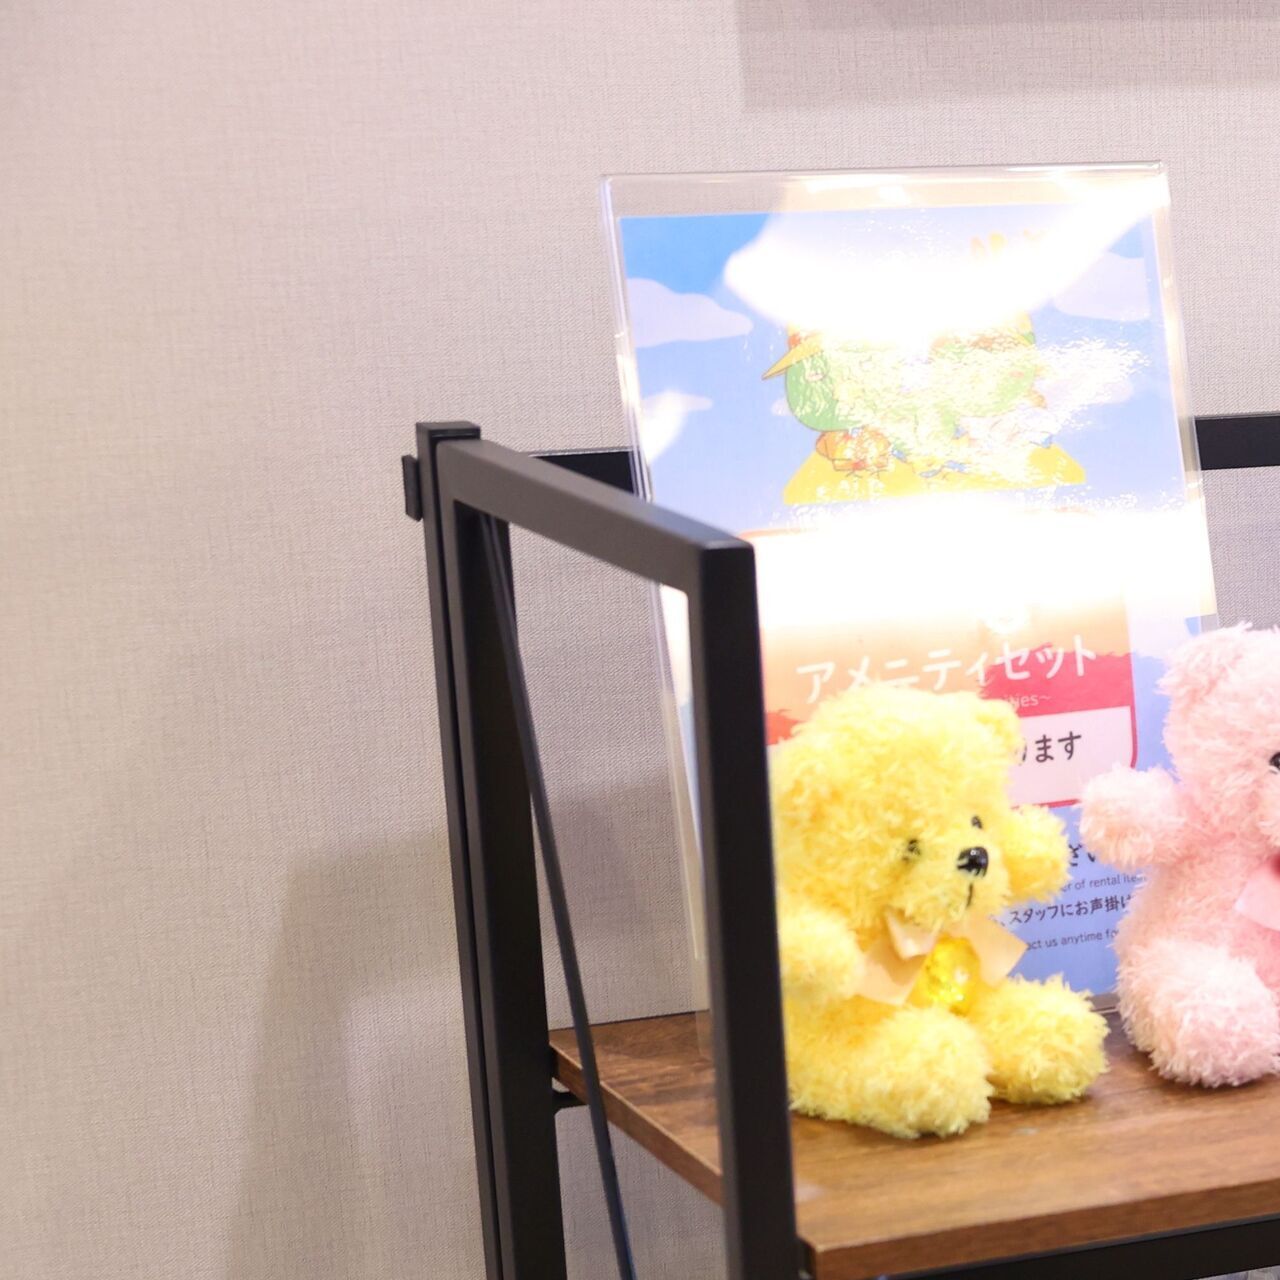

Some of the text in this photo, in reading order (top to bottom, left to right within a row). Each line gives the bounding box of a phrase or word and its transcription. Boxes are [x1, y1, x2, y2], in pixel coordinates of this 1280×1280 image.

[796, 634, 1097, 704] アメニティセット
[1074, 879, 1086, 891] of
[1089, 874, 1121, 888] rental
[1045, 938, 1059, 949] us
[1060, 931, 1103, 947] anytime
